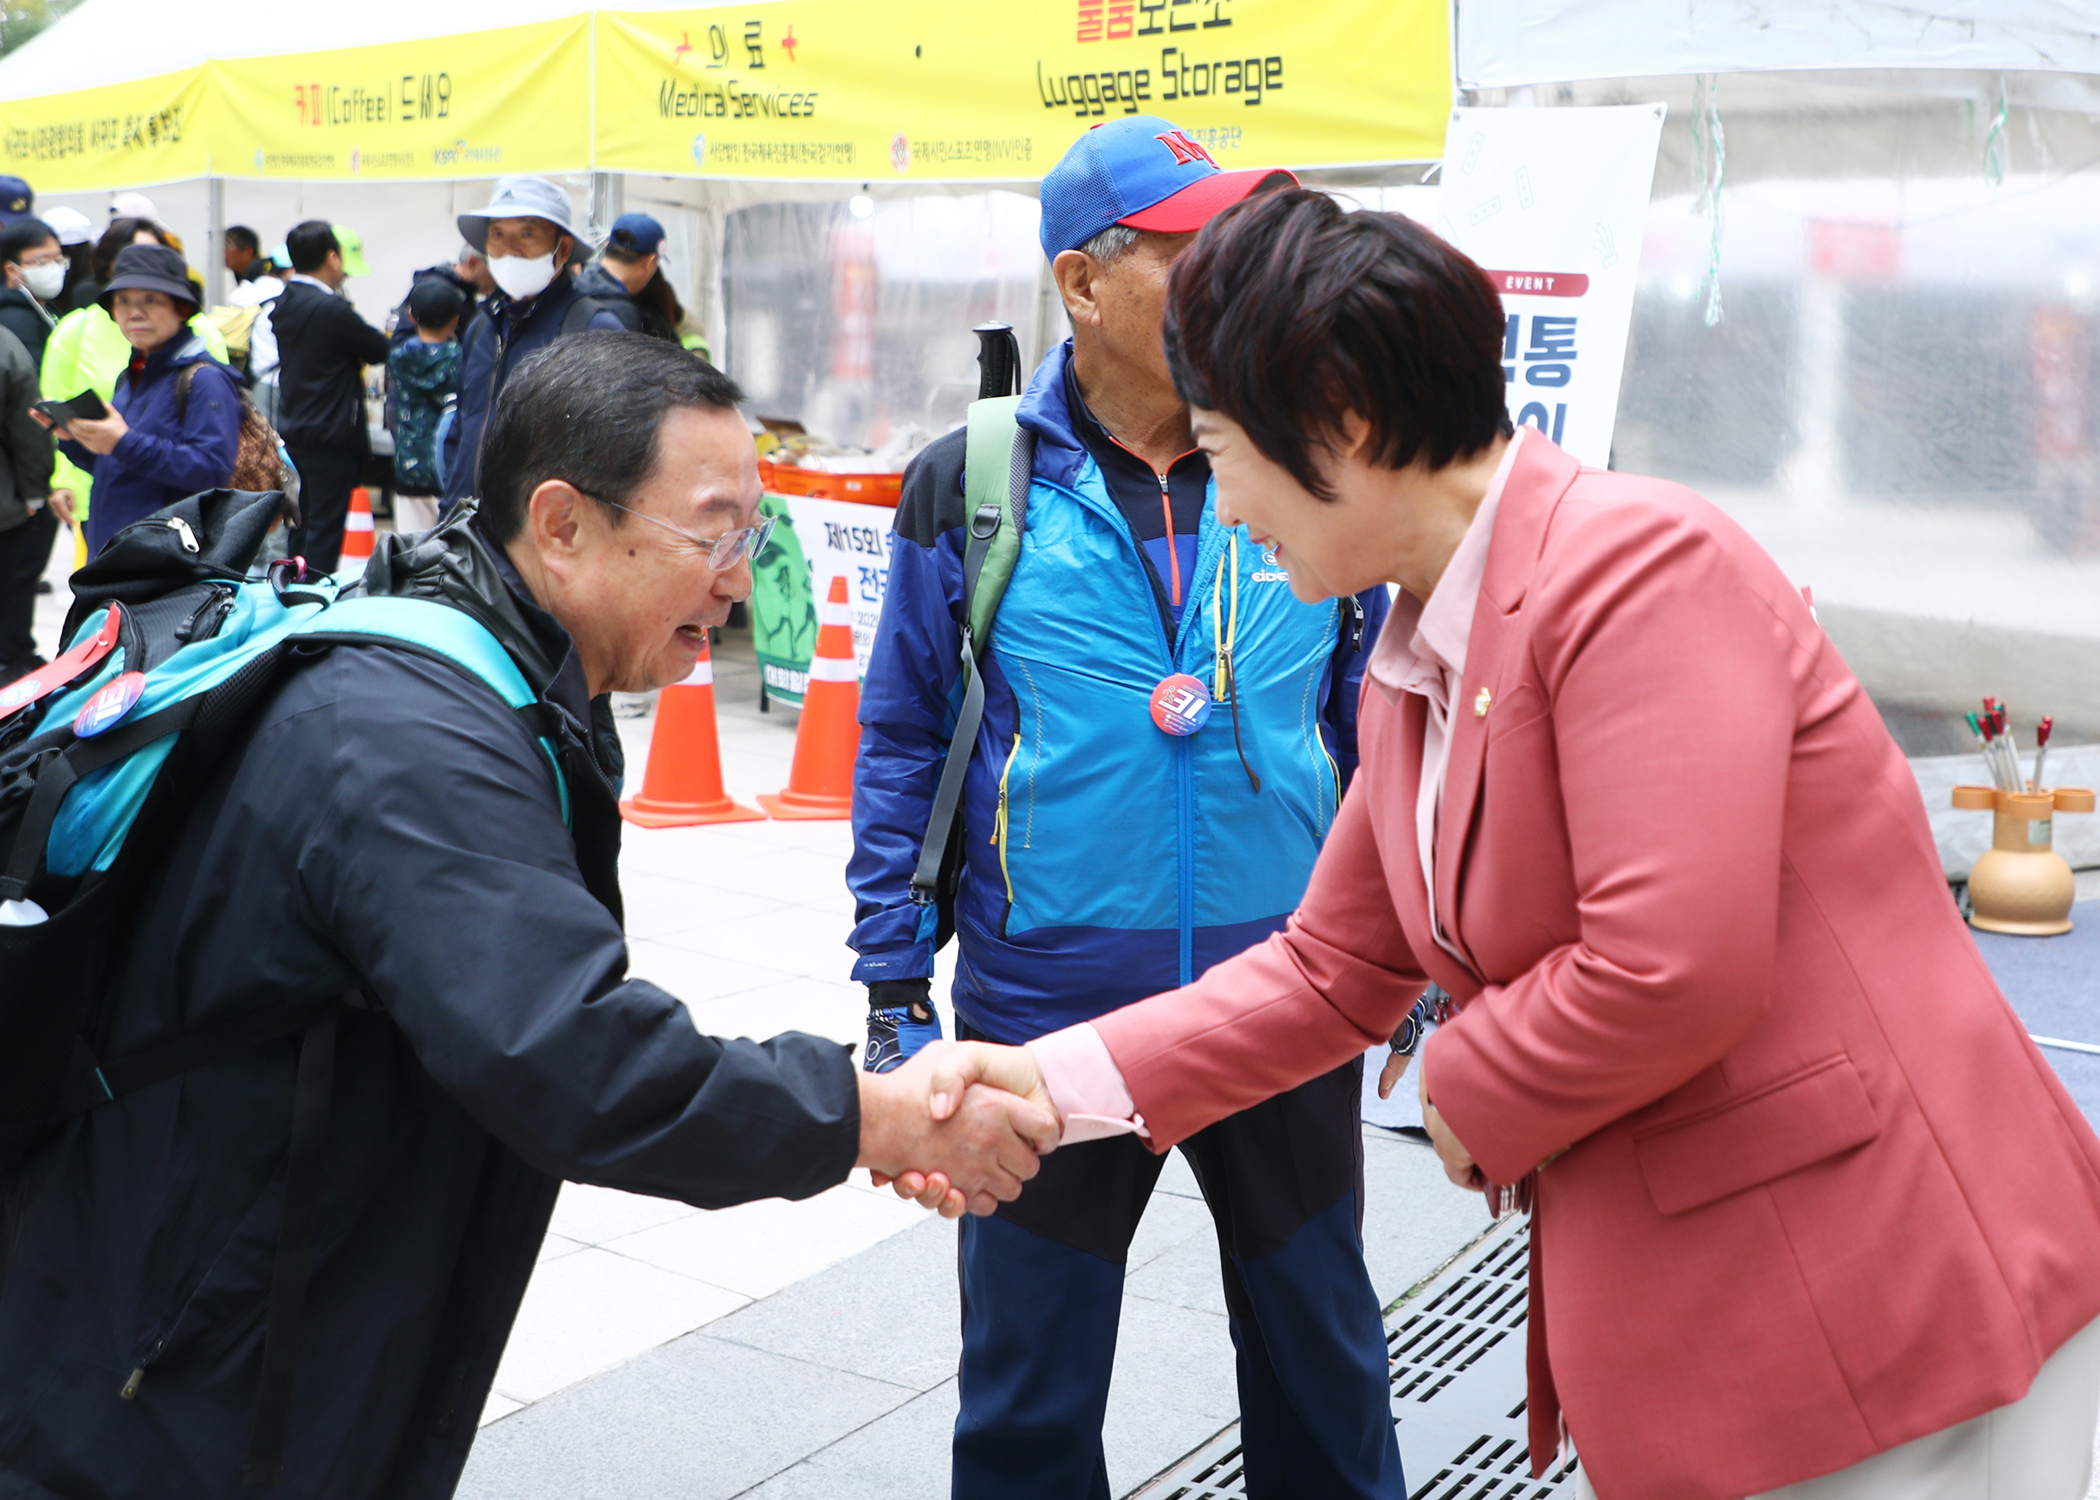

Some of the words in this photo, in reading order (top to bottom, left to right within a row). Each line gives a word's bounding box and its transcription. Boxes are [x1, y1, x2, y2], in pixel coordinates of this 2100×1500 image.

[402, 72, 452, 120] 드세요
[659, 79, 727, 118] Medical
[728, 79, 818, 119] Services
[1037, 59, 1152, 117] Luggage
[1162, 47, 1284, 106] Storage
[1505, 275, 1555, 291] EVENT
[824, 522, 884, 557] 제15회
